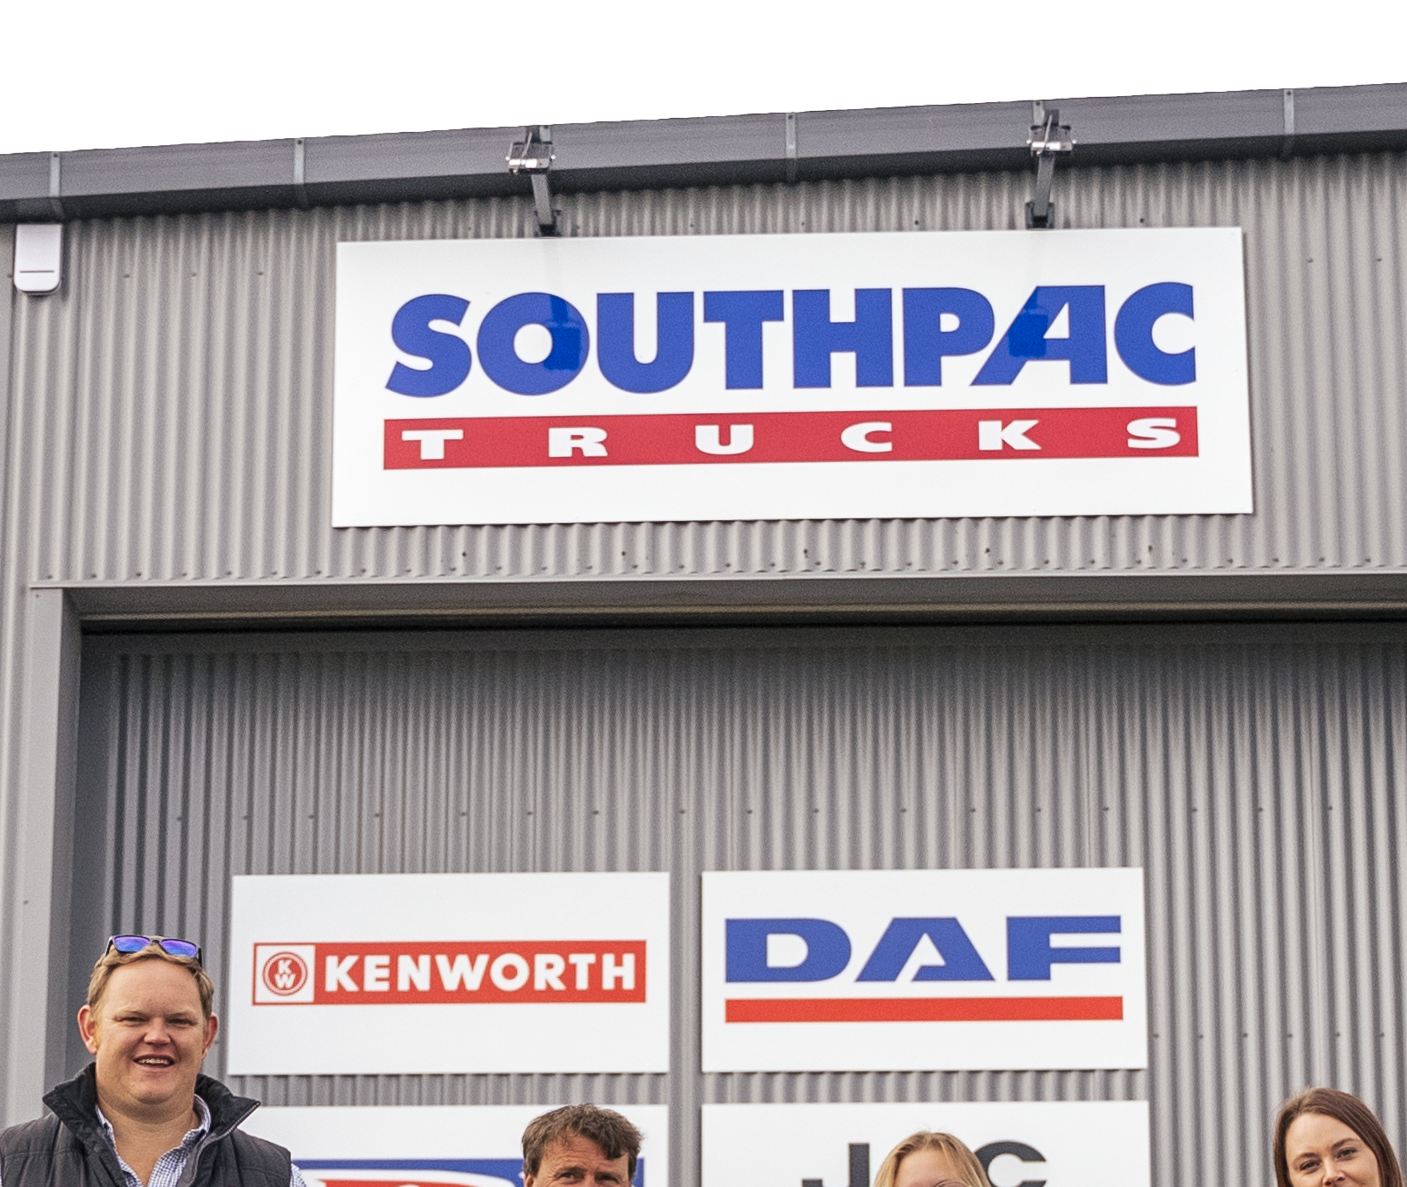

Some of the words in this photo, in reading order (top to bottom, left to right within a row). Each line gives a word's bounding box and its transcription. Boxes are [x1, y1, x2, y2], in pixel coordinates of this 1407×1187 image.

[385, 282, 1197, 398] SOUTHPAC
[401, 418, 1182, 461] TRUCKS
[324, 952, 636, 993] KENWORTH
[725, 915, 1122, 984] DAF
